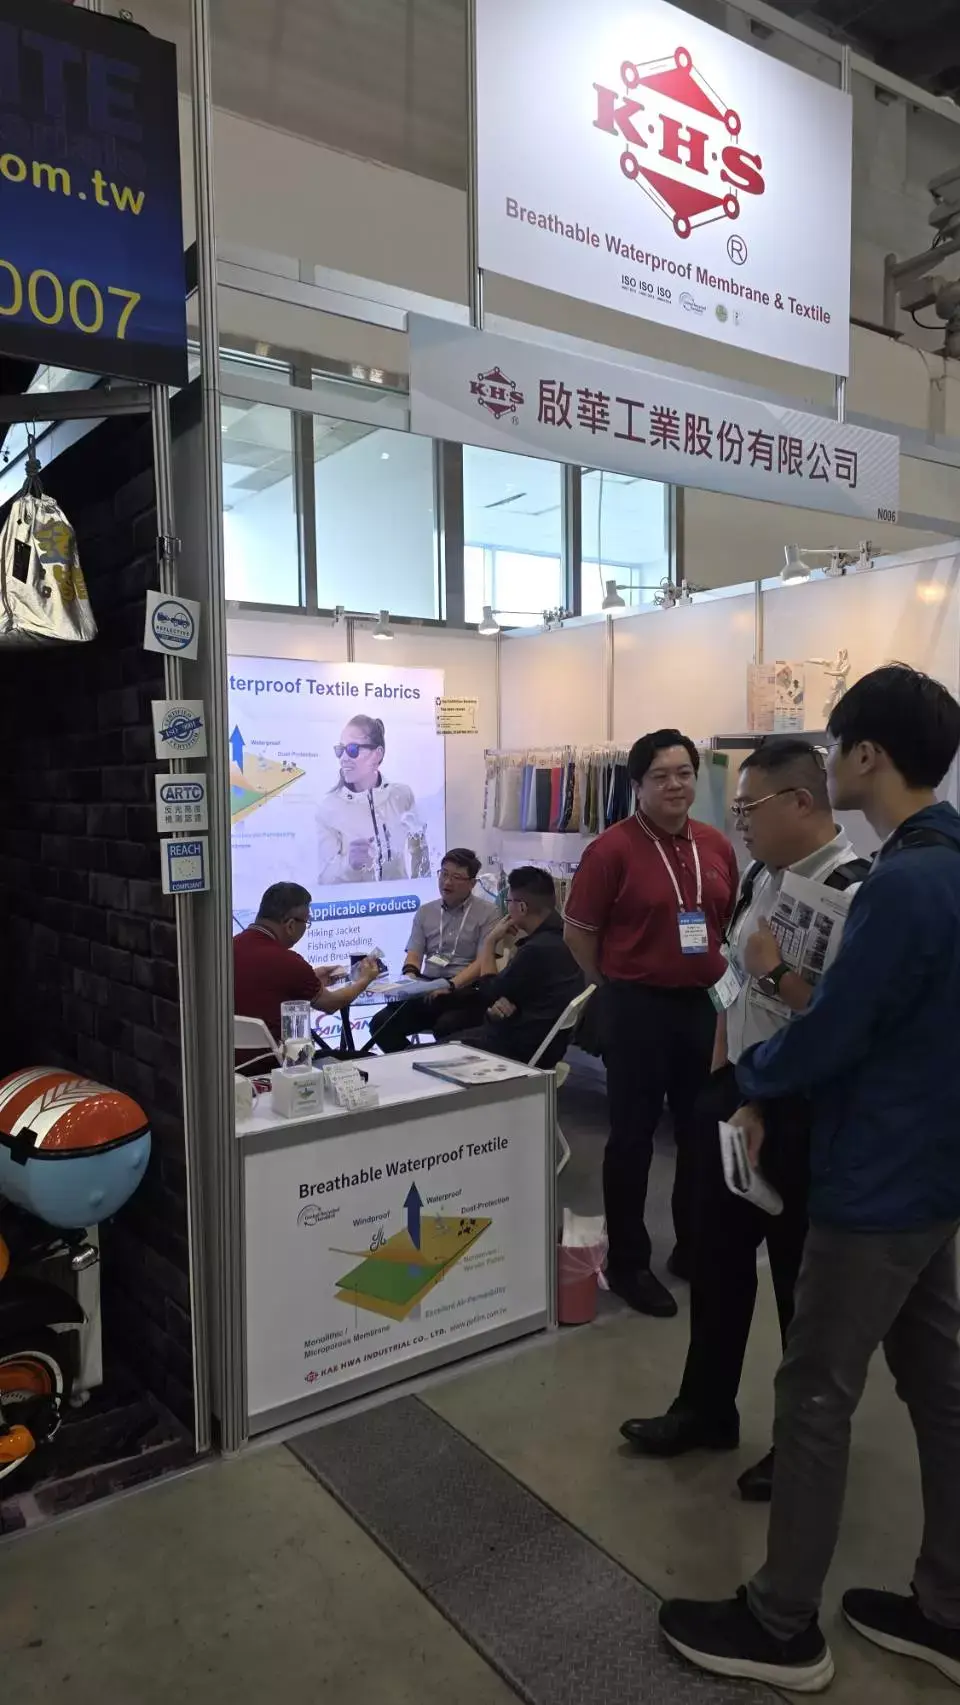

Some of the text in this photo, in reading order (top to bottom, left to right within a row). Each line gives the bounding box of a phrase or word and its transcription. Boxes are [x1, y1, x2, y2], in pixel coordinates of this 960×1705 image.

[505, 197, 600, 248] Breathable
[605, 234, 692, 280] Waterproof
[696, 266, 770, 306] Membrane
[774, 294, 784, 310] &
[788, 297, 831, 324] Textile
[621, 275, 636, 287] ISO
[639, 281, 654, 293] ISO
[657, 286, 672, 299] ISO
[538, 379, 858, 489] 啟華工業股份有限公司
[230, 675, 421, 700] terproof Textile Fabrics
[166, 787, 201, 800] ARTC
[170, 843, 201, 856] REACH
[369, 899, 417, 912] Products
[307, 926, 361, 938] Hiking Jacket
[307, 940, 337, 951] Fishing
[307, 954, 328, 964] Wind
[299, 1136, 508, 1199] Breathable Waterproof Textile
[426, 1189, 462, 1205] Waterproof
[353, 1210, 390, 1227] Windproof
[340, 1357, 361, 1370] HWA
[363, 1339, 411, 1361] INDUSTRIAL
